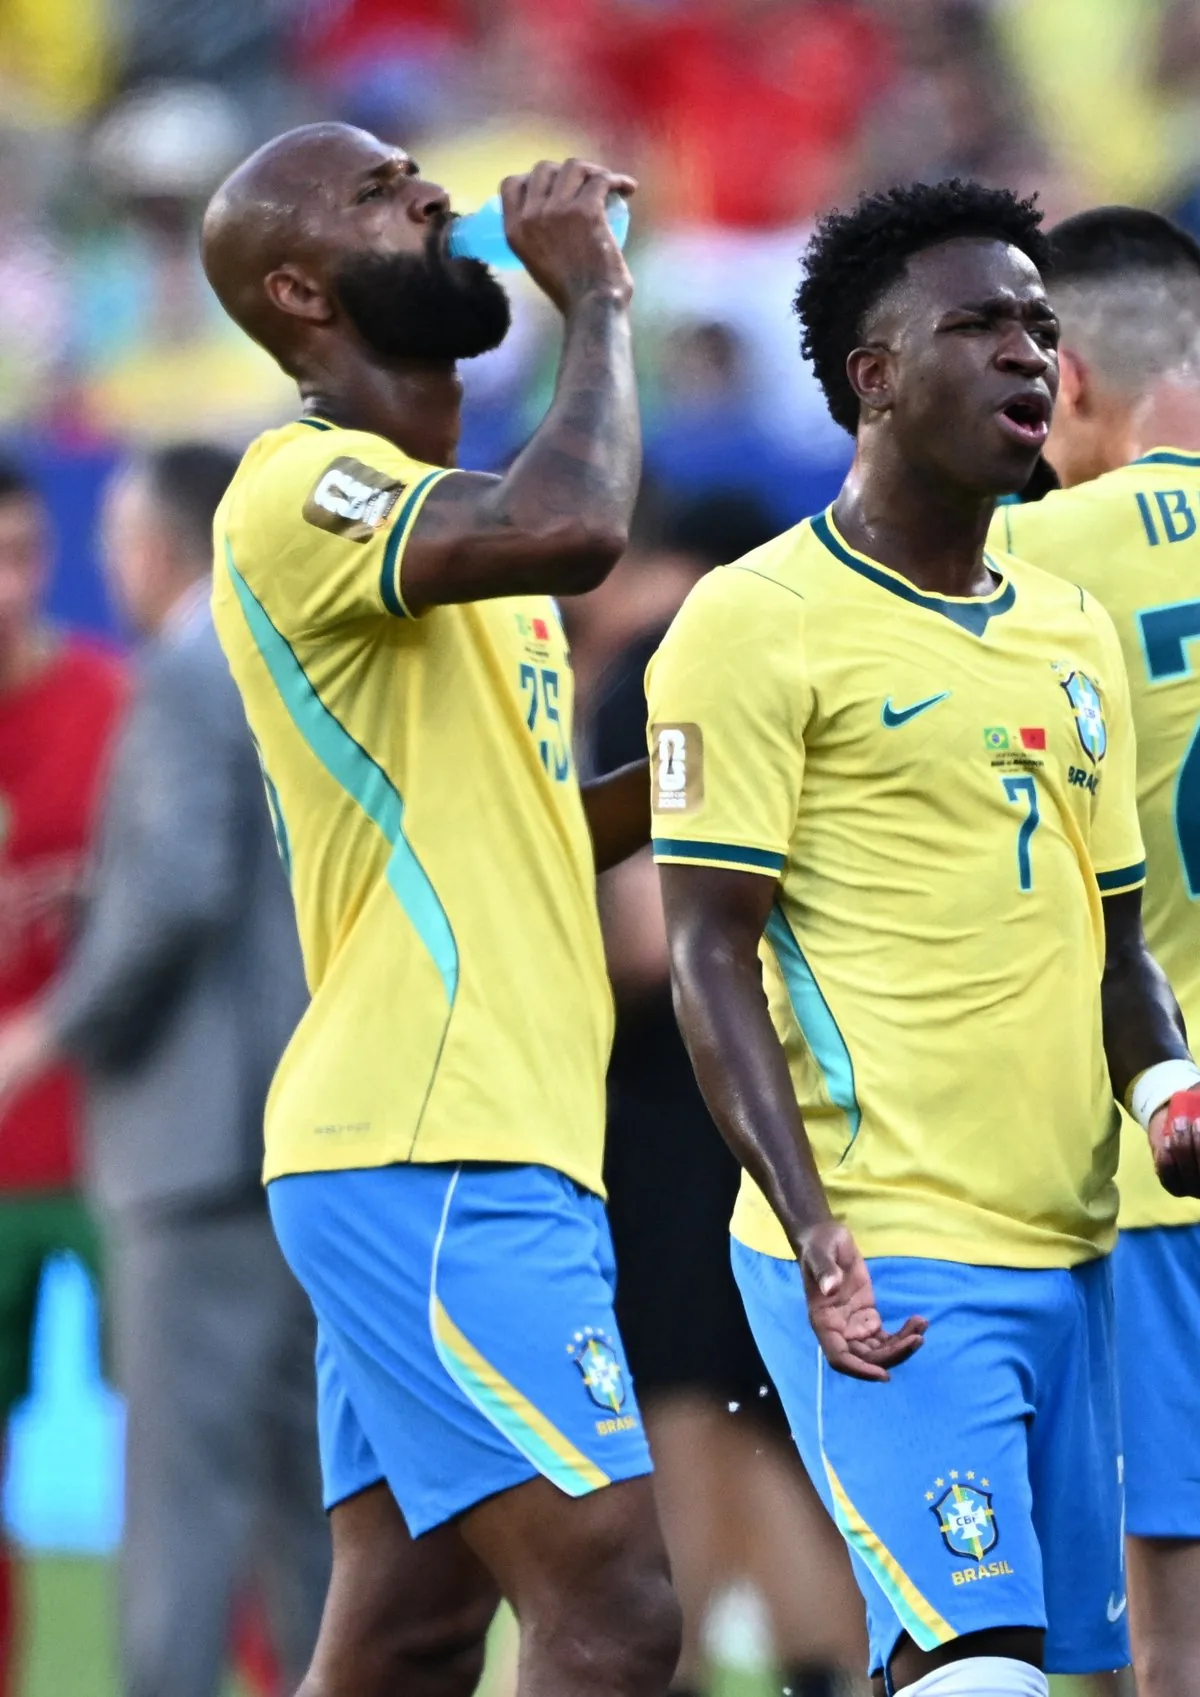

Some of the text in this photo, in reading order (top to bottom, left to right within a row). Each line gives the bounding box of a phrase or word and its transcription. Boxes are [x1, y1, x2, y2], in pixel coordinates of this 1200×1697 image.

[519, 663, 568, 782] 25
[1001, 777, 1039, 891] 7
[951, 1561, 1014, 1585] BRASIL
